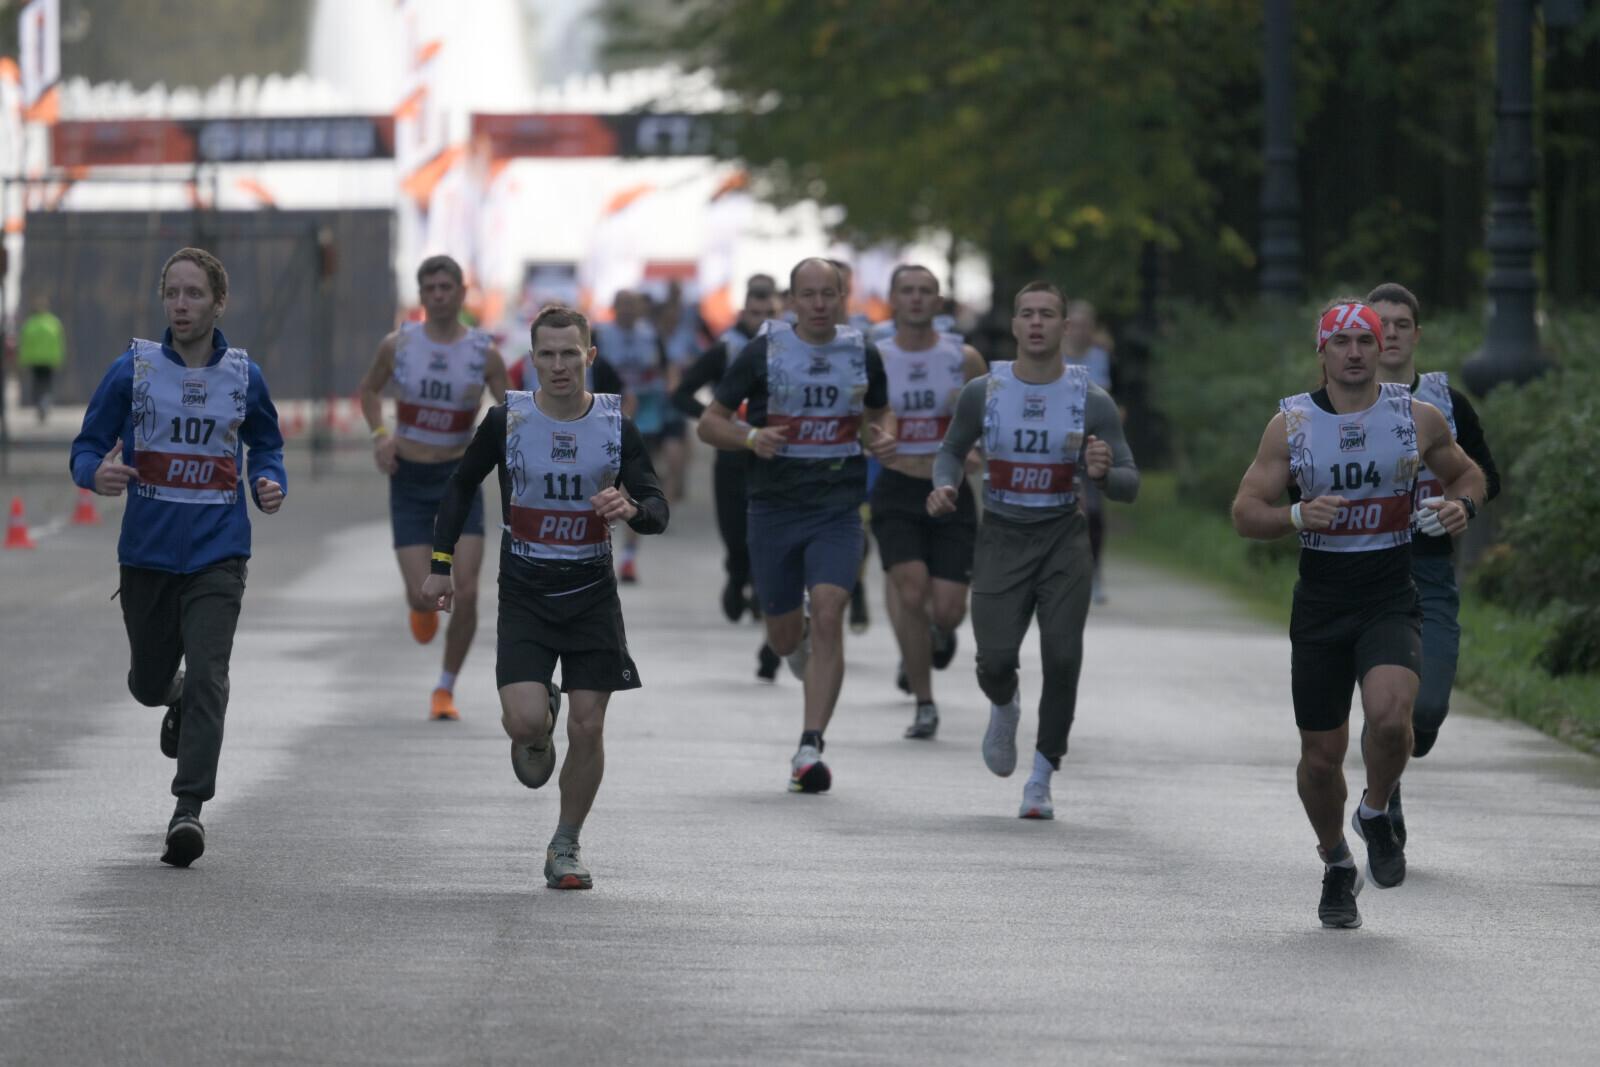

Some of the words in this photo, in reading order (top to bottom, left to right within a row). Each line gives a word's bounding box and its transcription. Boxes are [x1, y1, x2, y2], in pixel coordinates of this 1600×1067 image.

[419, 378, 452, 401] 101
[803, 385, 839, 408] 119
[902, 390, 935, 411] 118
[170, 417, 216, 445] 107
[416, 409, 453, 429] PRO
[900, 420, 938, 439] PRO
[1013, 429, 1051, 454] 121
[166, 459, 215, 484] PRO
[1011, 467, 1053, 489] PRO
[1330, 461, 1381, 491] 104
[543, 472, 584, 500] 111
[539, 515, 588, 541] PRO
[1330, 503, 1383, 531] PRO
